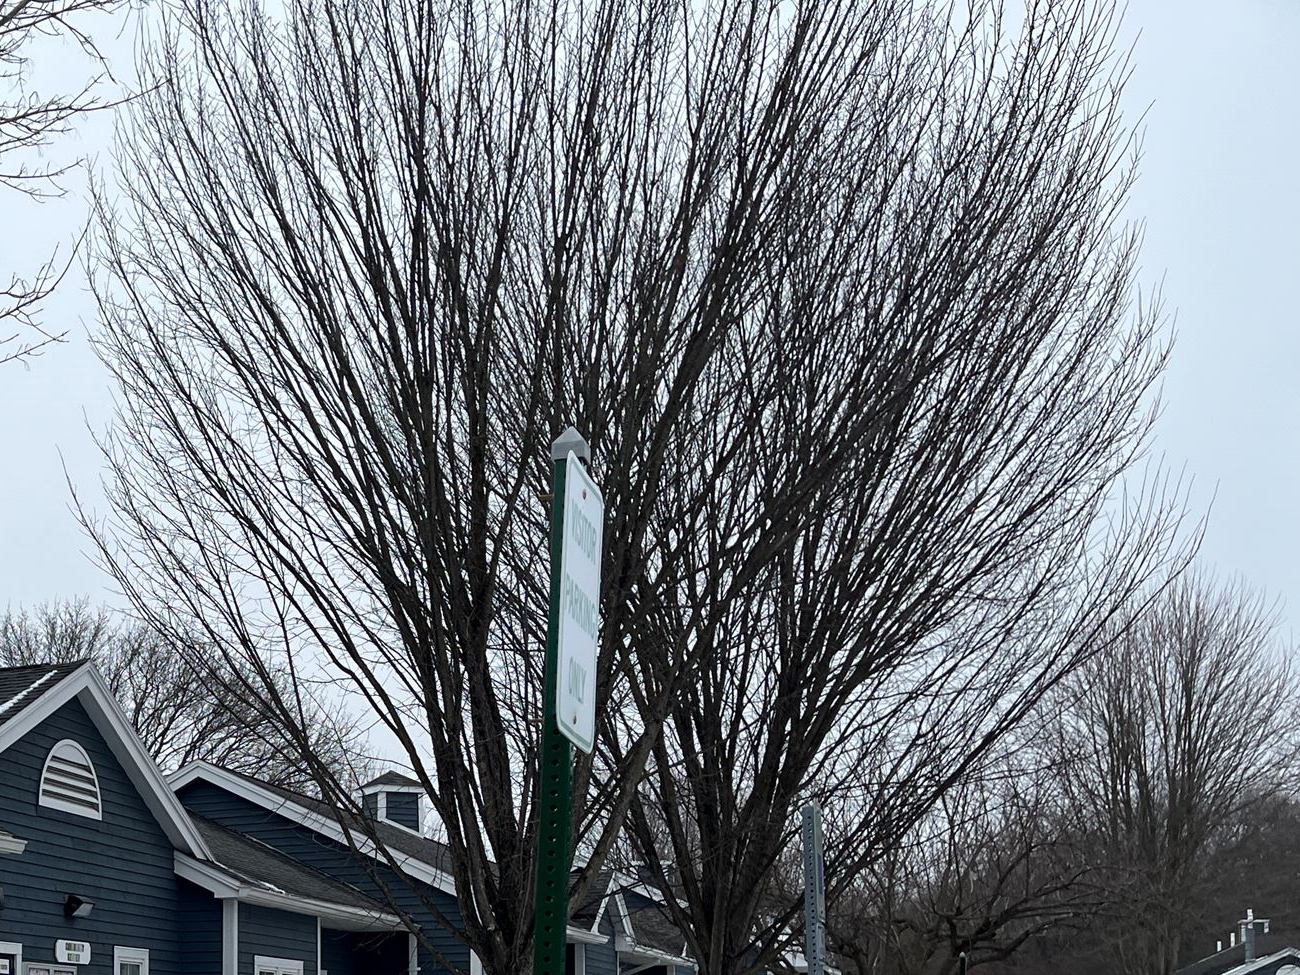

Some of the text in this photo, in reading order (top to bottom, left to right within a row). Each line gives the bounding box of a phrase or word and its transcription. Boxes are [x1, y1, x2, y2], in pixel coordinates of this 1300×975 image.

[571, 499, 597, 566] VISITOR
[564, 572, 596, 640] PARKING
[568, 656, 587, 704] ONLY
